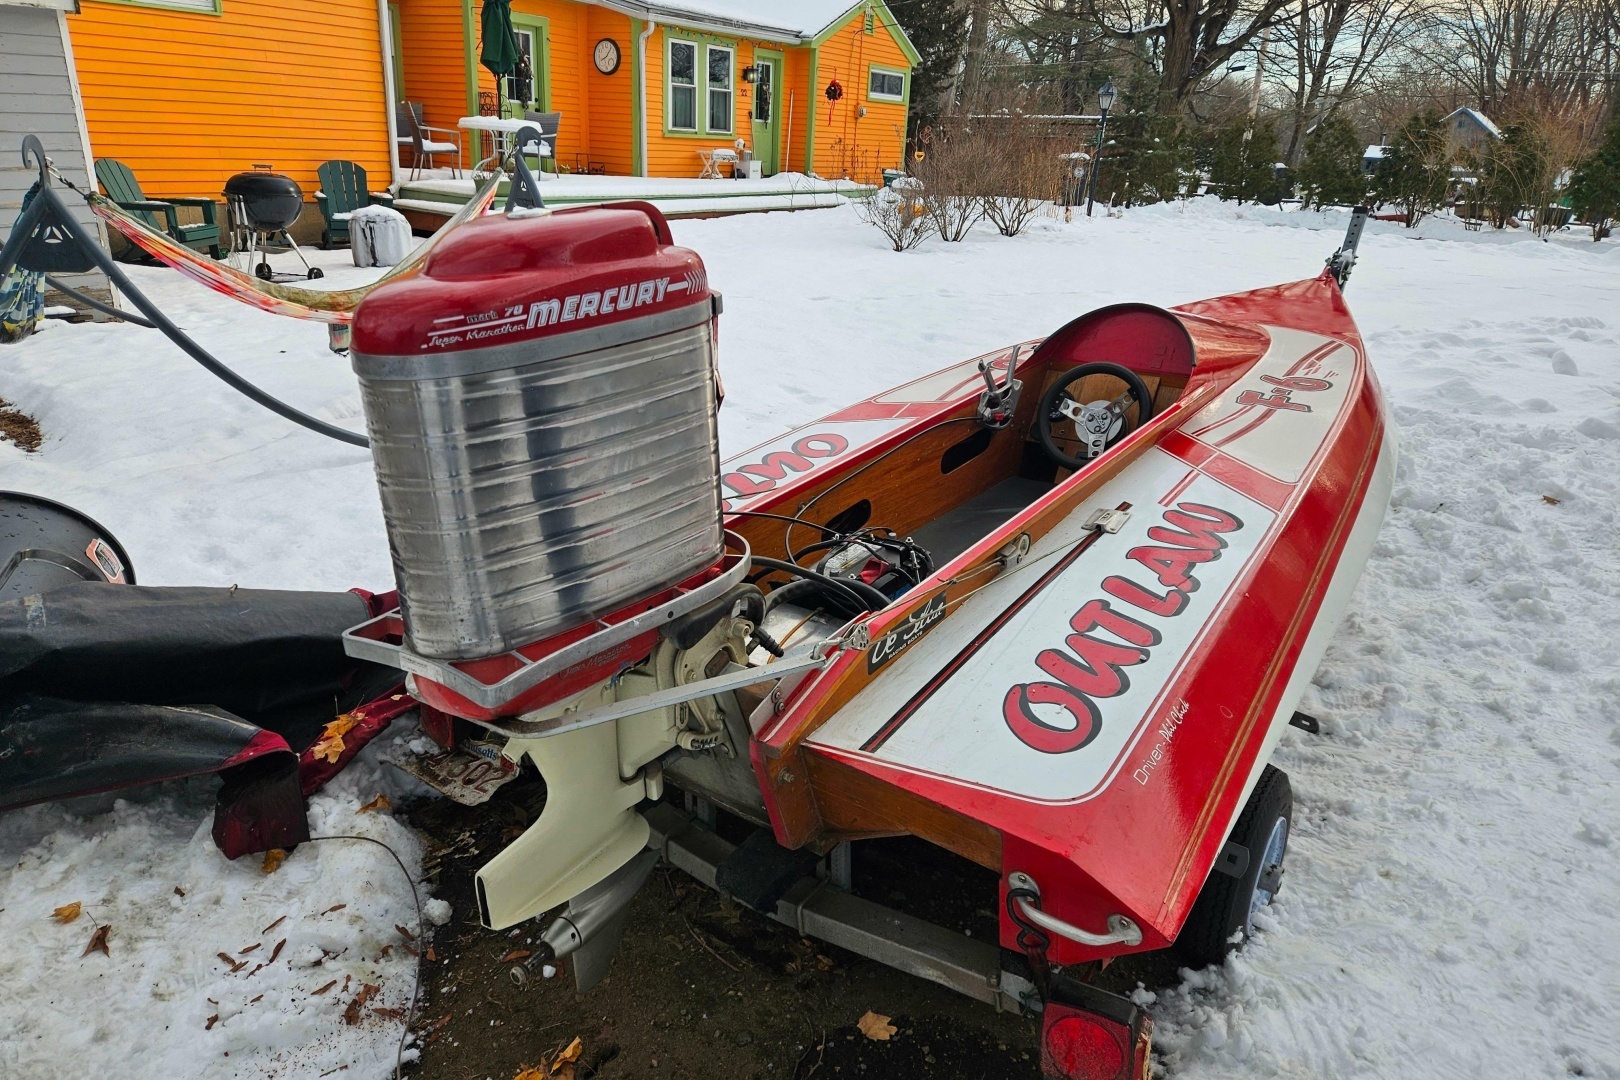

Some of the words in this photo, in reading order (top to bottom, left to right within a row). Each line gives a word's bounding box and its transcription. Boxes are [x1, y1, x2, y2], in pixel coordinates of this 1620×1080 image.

[526, 276, 671, 330] MERCURY
[466, 323, 526, 341] Marathon
[1002, 502, 1245, 755] OUTLAW
